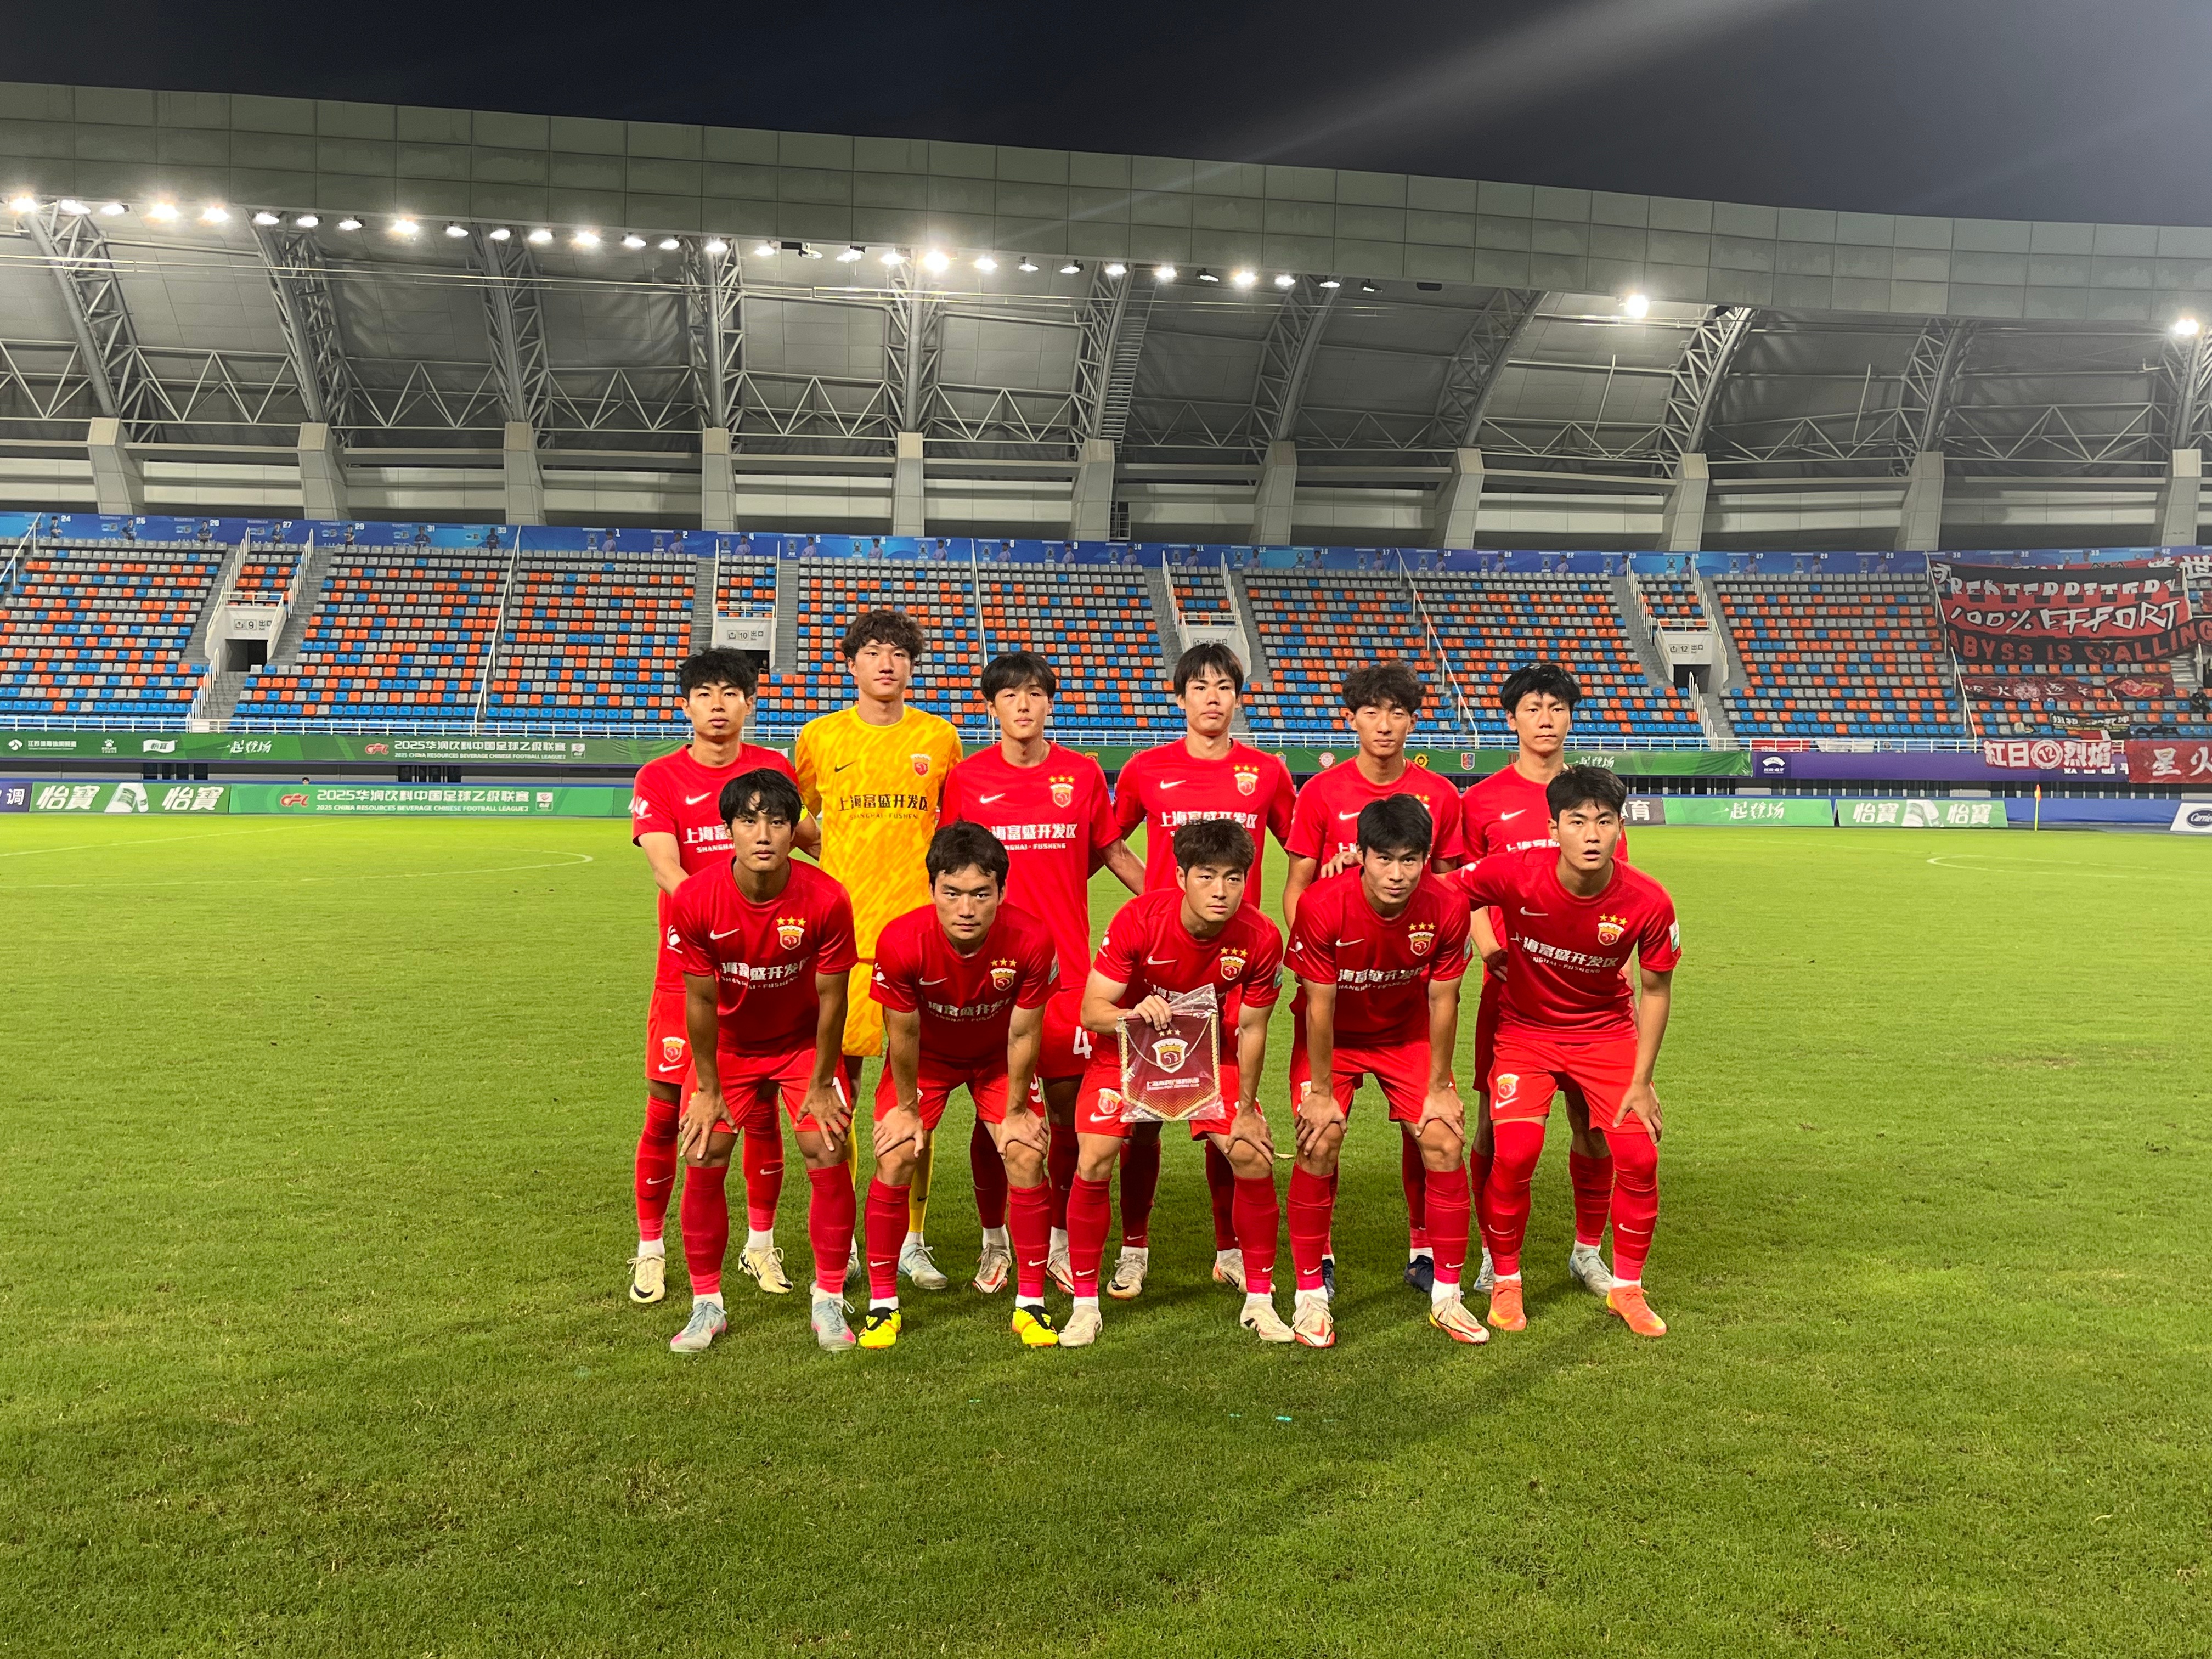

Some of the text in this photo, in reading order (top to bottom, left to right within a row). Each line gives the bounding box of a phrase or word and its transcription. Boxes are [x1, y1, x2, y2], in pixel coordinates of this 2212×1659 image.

[615, 529, 621, 537] 1
[682, 531, 688, 539] 2
[2040, 601, 2181, 635] EFFORT
[2046, 644, 2072, 661] IS
[2038, 746, 2056, 761] 12
[0, 788, 25, 805] 调
[317, 789, 529, 802] 2025华润饮料中国足球乙级联赛
[838, 794, 929, 811] 上海富盛开发区
[990, 823, 1078, 841] 海富盛开发区
[1073, 1025, 1093, 1059] 4
